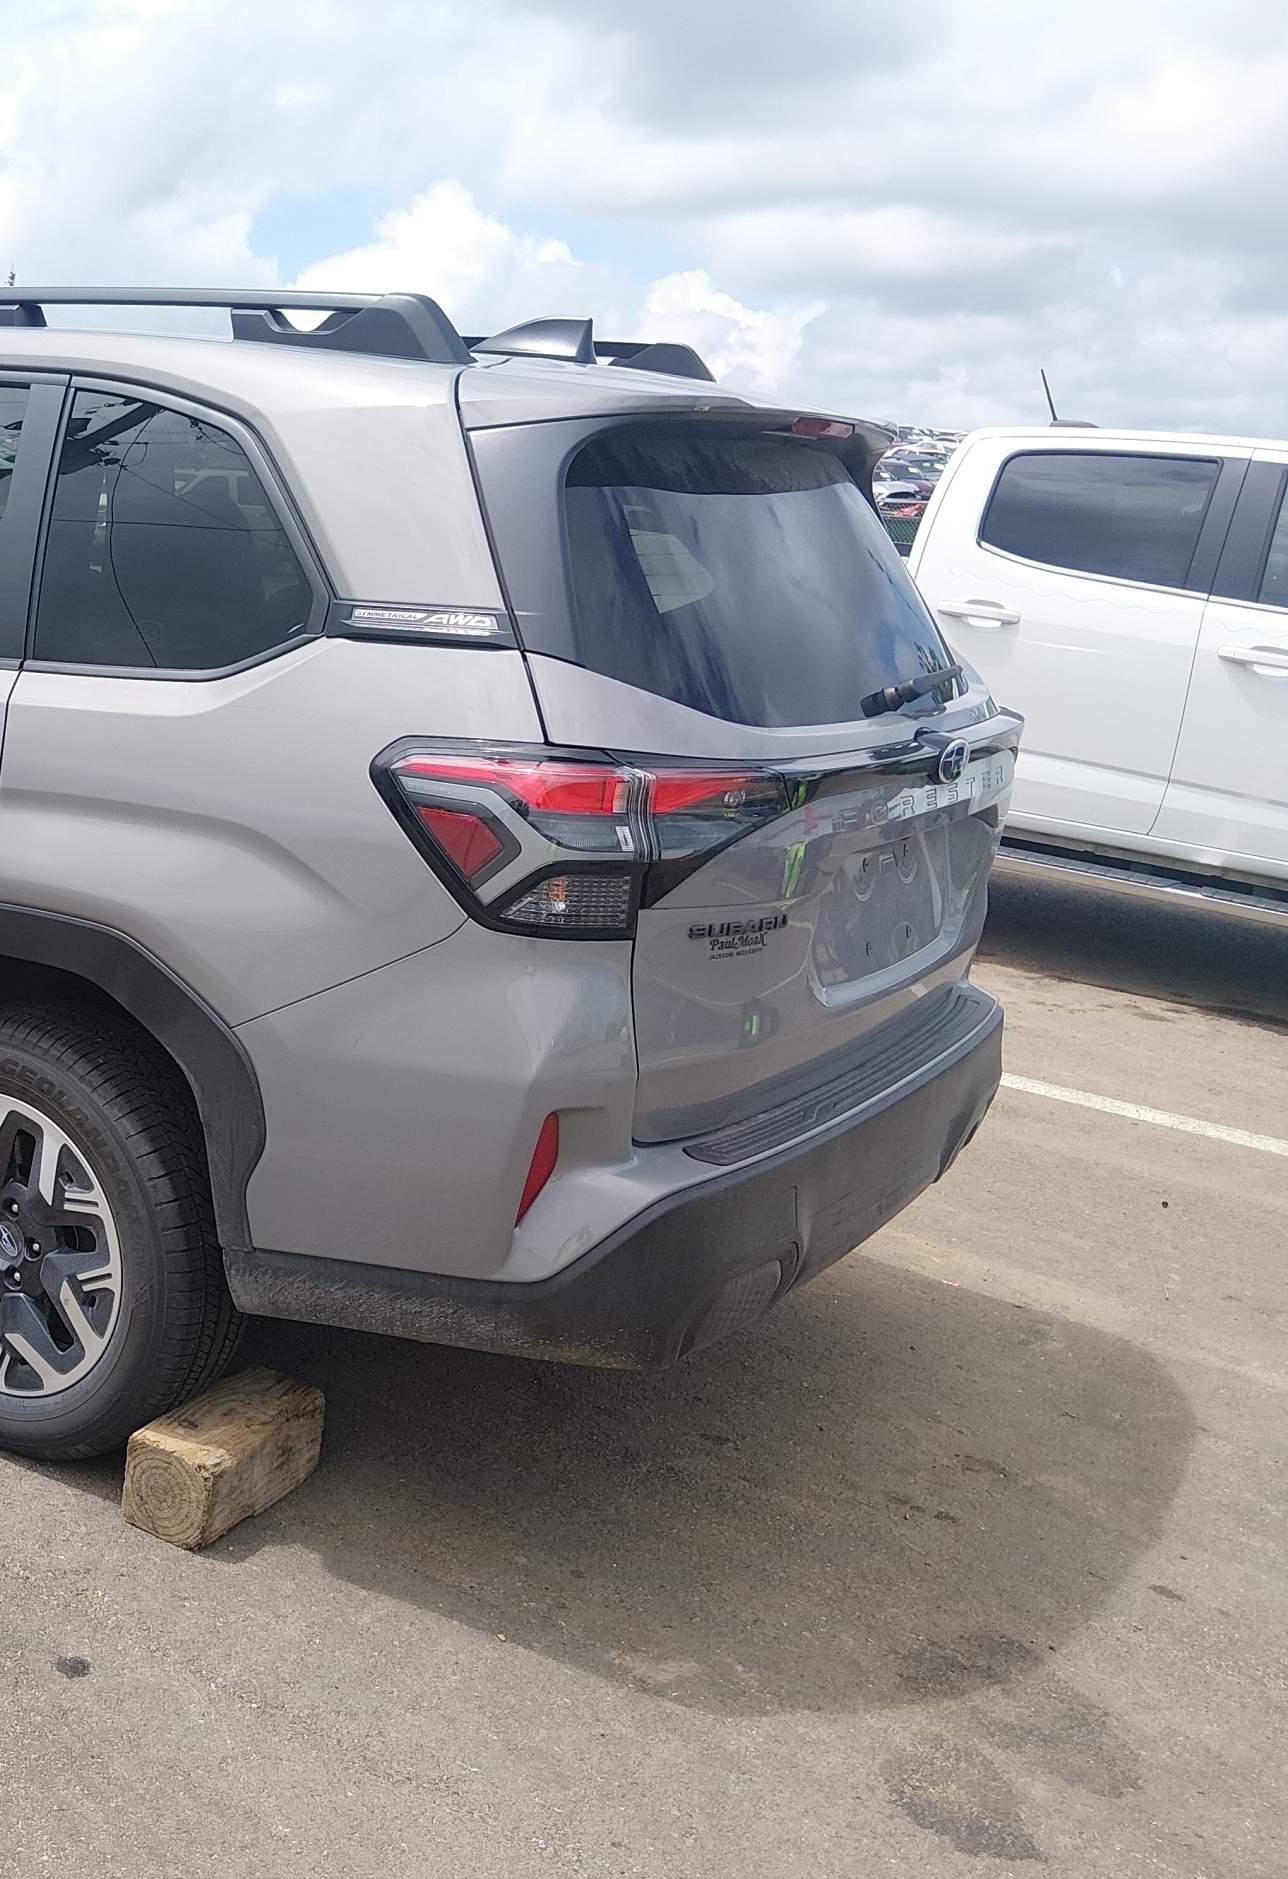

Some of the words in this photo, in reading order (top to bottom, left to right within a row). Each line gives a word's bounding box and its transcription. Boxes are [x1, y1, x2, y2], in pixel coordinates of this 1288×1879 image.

[355, 608, 420, 621] SYMMETRICAL
[423, 612, 492, 627] AWD
[688, 912, 789, 939] SUBARU
